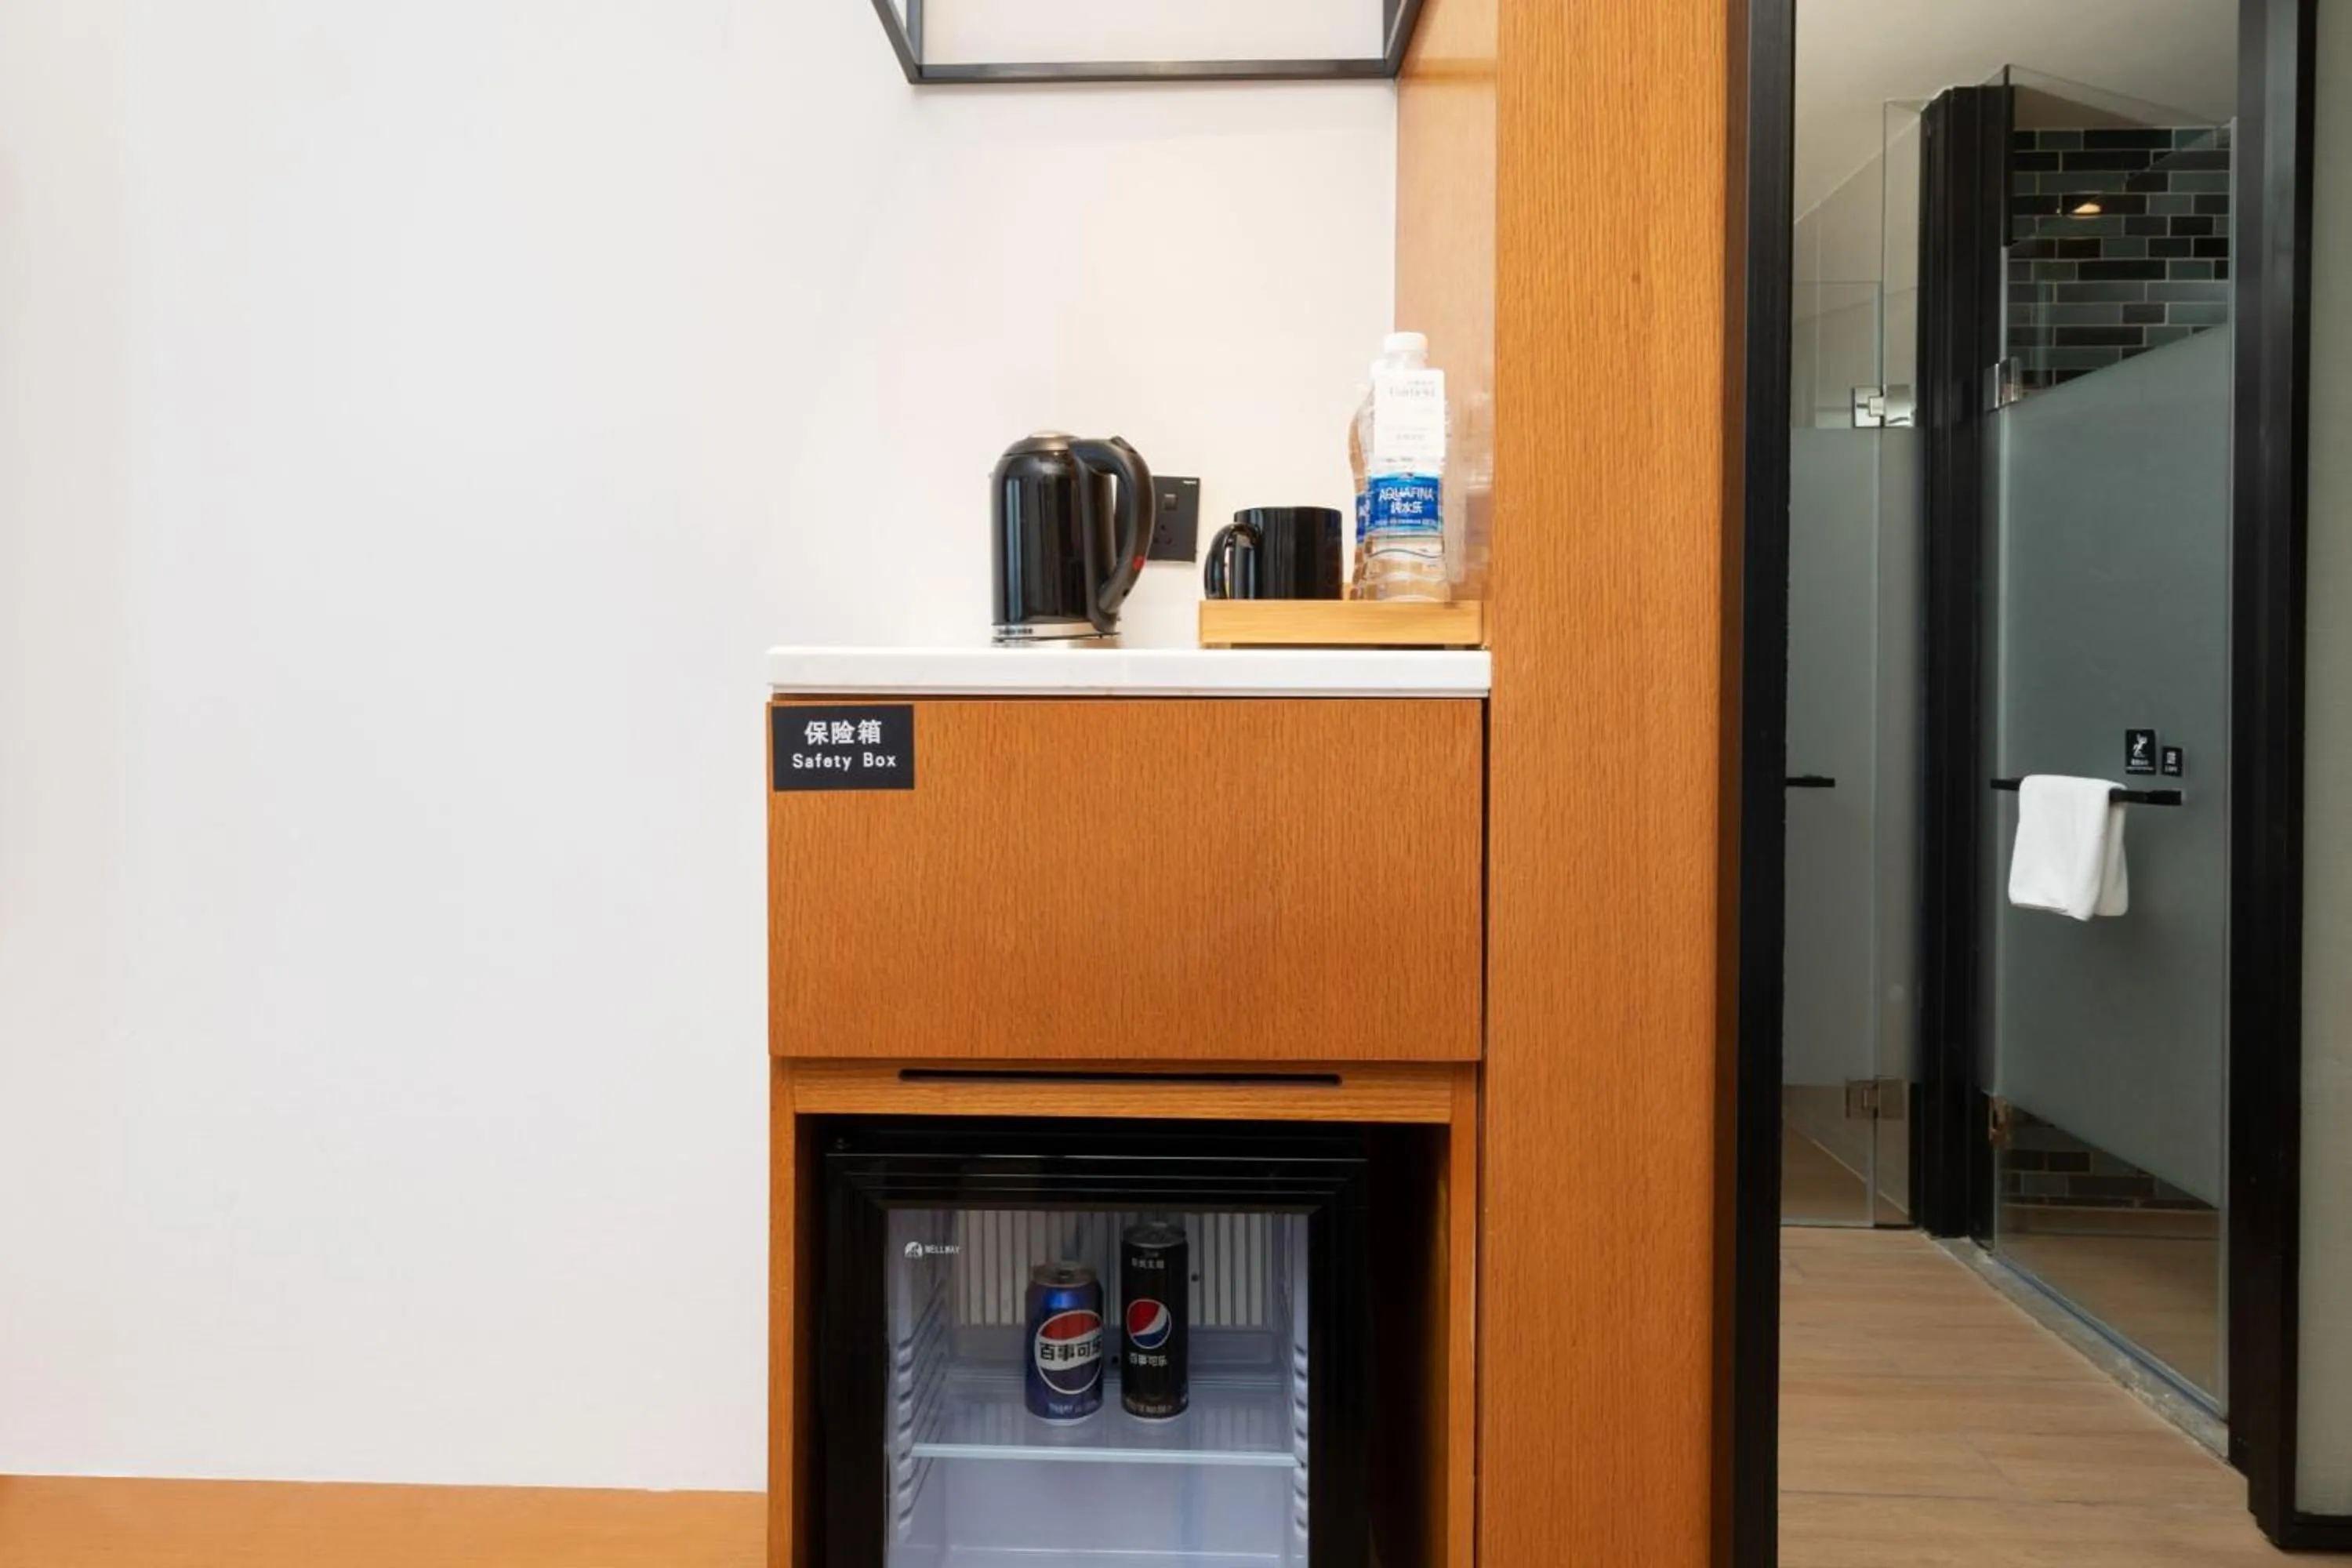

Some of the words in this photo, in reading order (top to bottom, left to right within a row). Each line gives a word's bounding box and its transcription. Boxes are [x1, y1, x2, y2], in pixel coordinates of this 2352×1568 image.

[1378, 487, 1434, 501] AQUAFINA
[804, 719, 882, 745] 保险箱
[793, 753, 852, 771] Safety
[863, 752, 896, 768] Box
